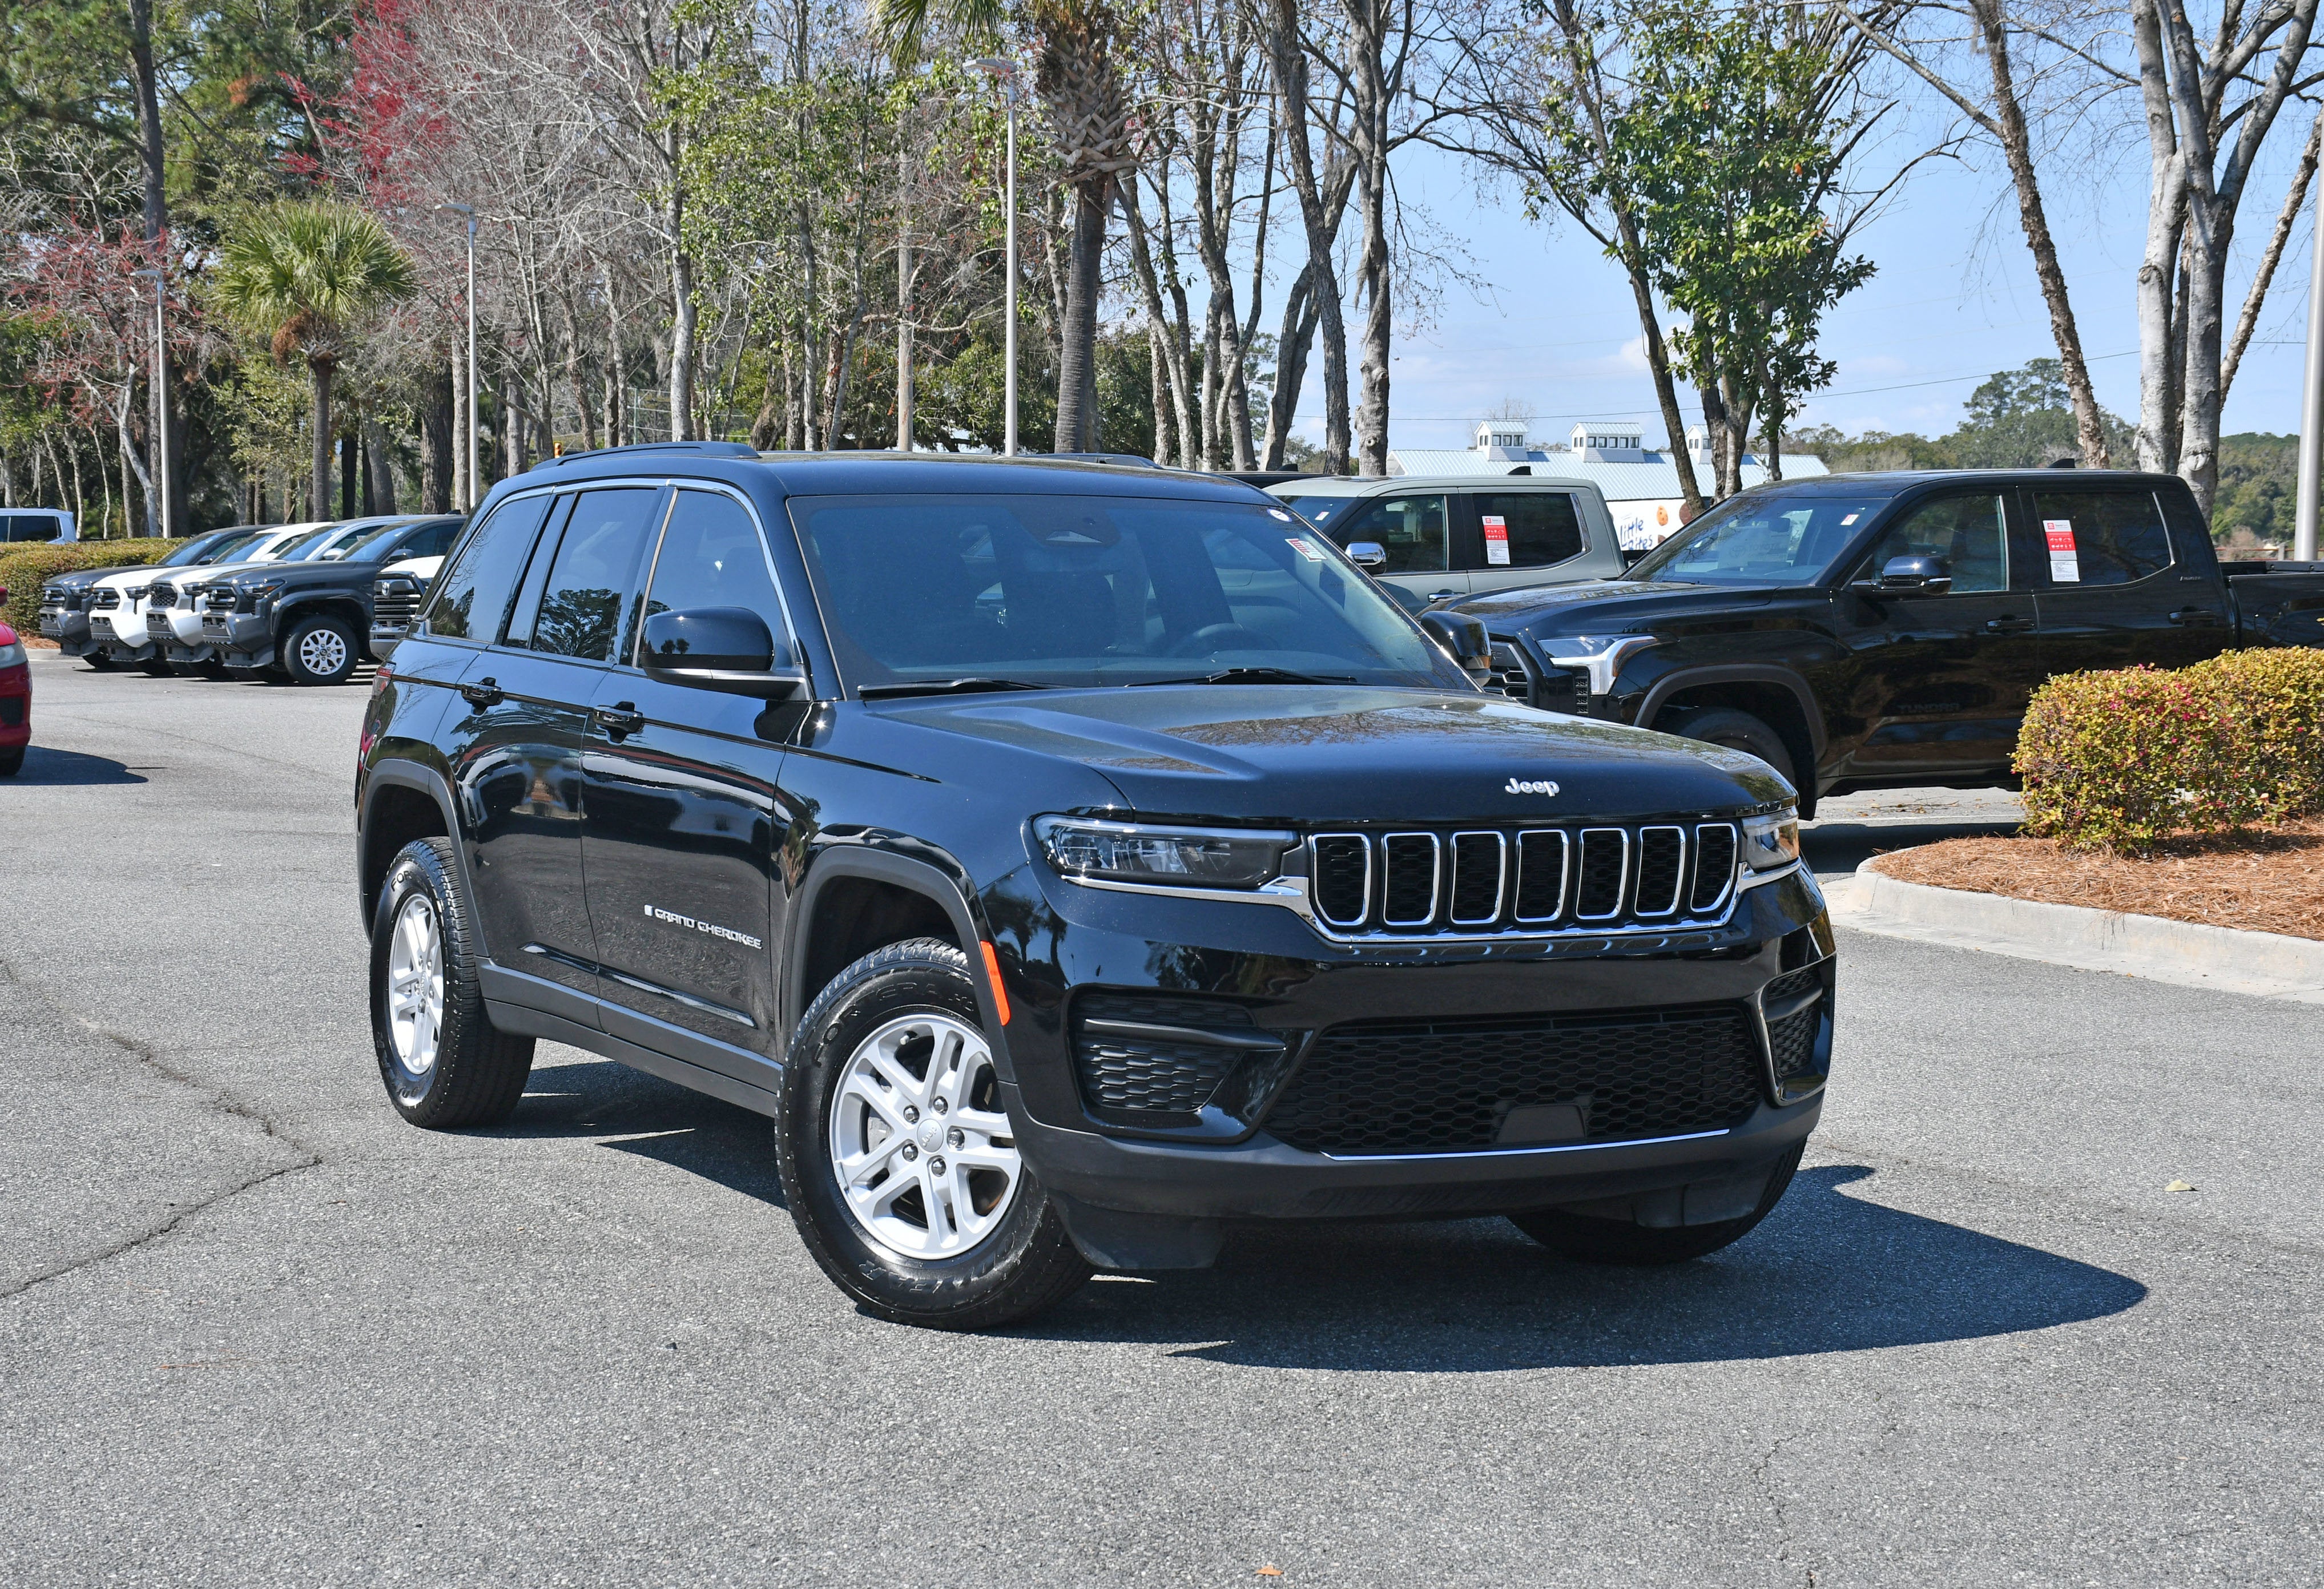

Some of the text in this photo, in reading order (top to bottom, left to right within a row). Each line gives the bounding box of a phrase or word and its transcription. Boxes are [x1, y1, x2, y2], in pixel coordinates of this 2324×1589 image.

[1620, 517, 1644, 547] Little
[1505, 777, 1560, 797] Jeep
[654, 908, 762, 950] GRAND CHEROKEE
[921, 1126, 938, 1148] Jeep
